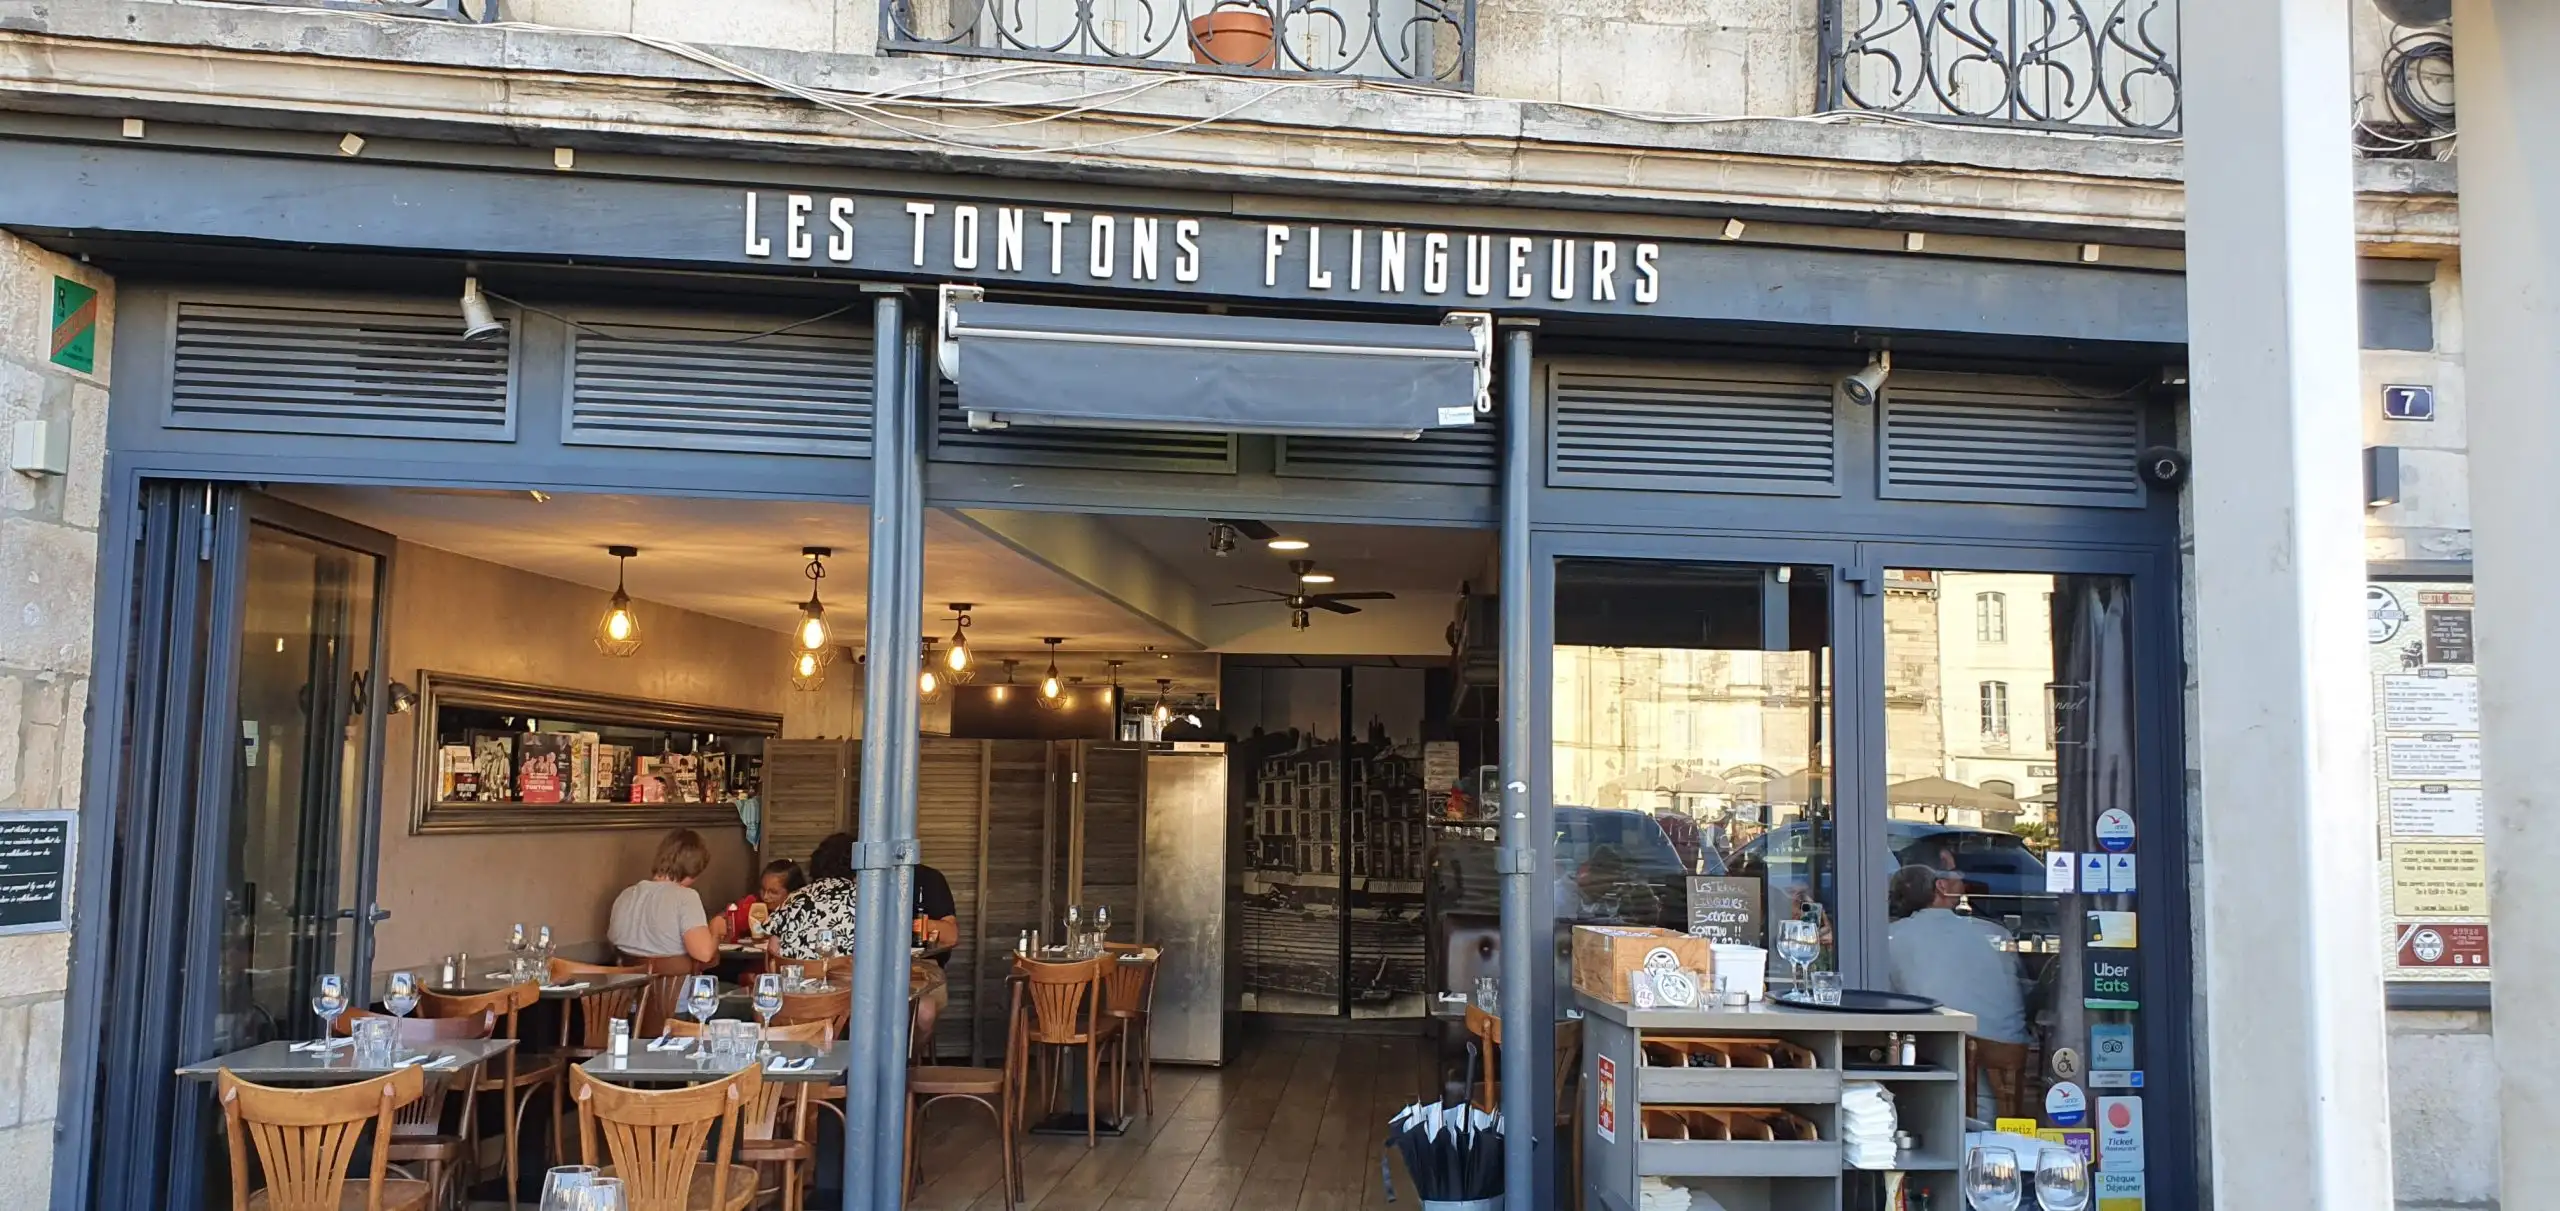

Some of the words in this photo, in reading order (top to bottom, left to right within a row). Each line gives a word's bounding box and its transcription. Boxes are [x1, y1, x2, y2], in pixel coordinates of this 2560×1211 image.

[745, 191, 856, 263] LES
[906, 201, 1201, 283] TONTONS
[1265, 223, 1662, 305] FLINGUEURS
[2400, 390, 2416, 415] 7
[2094, 962, 2129, 976] Uber
[2094, 978, 2129, 992] Eats
[2107, 1137, 2134, 1146] Ticket
